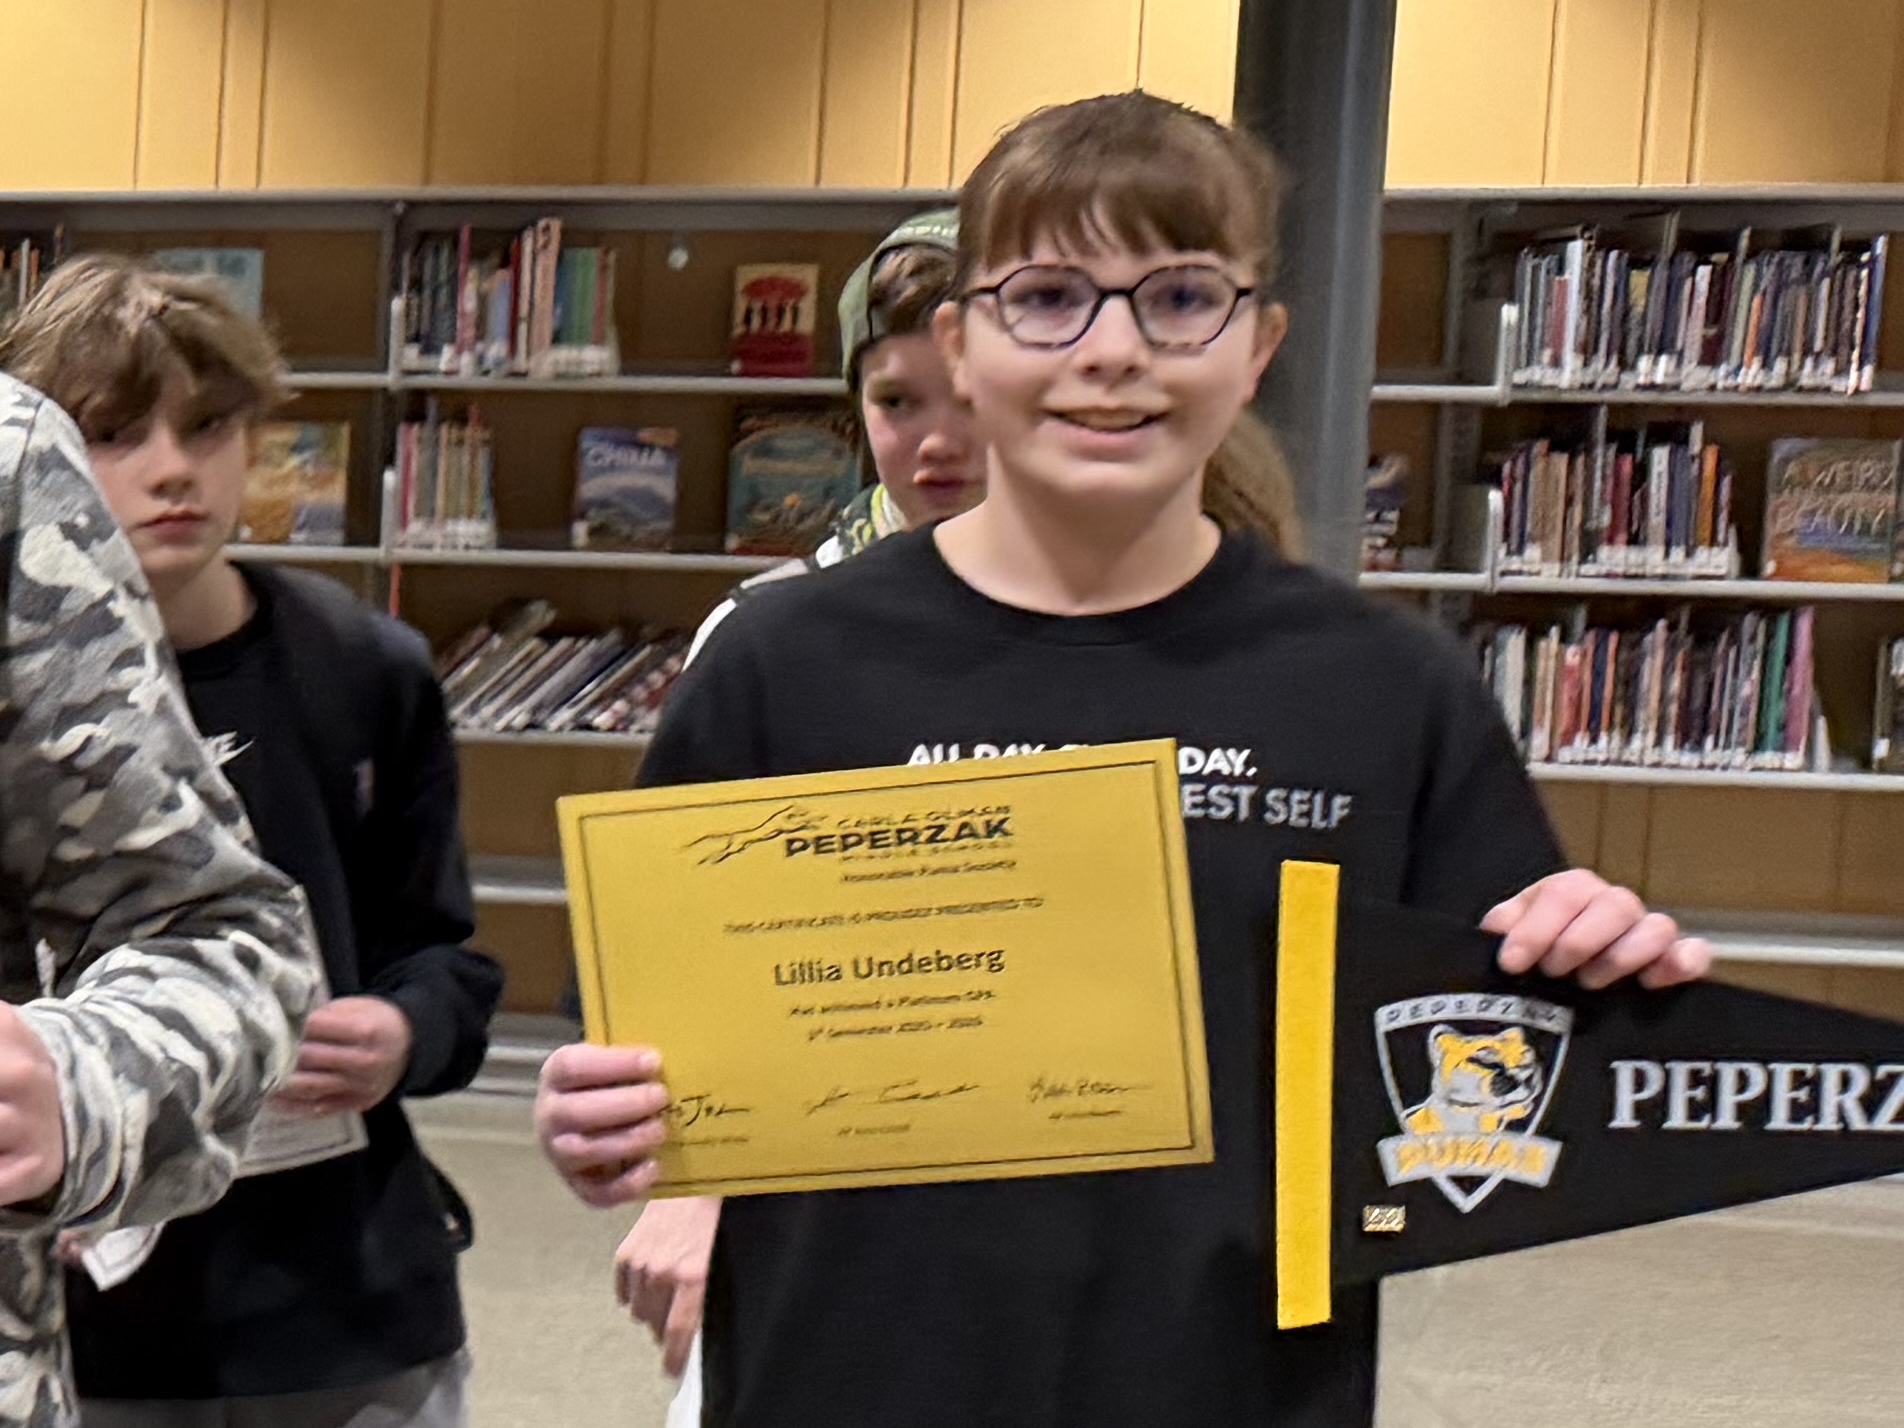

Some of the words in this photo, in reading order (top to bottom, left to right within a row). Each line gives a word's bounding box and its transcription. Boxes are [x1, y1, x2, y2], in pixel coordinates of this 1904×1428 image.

[1181, 783, 1259, 822] EST
[1263, 787, 1353, 830] SELF
[785, 816, 1014, 859] PEPERZAK
[852, 949, 1006, 979] Undeberg
